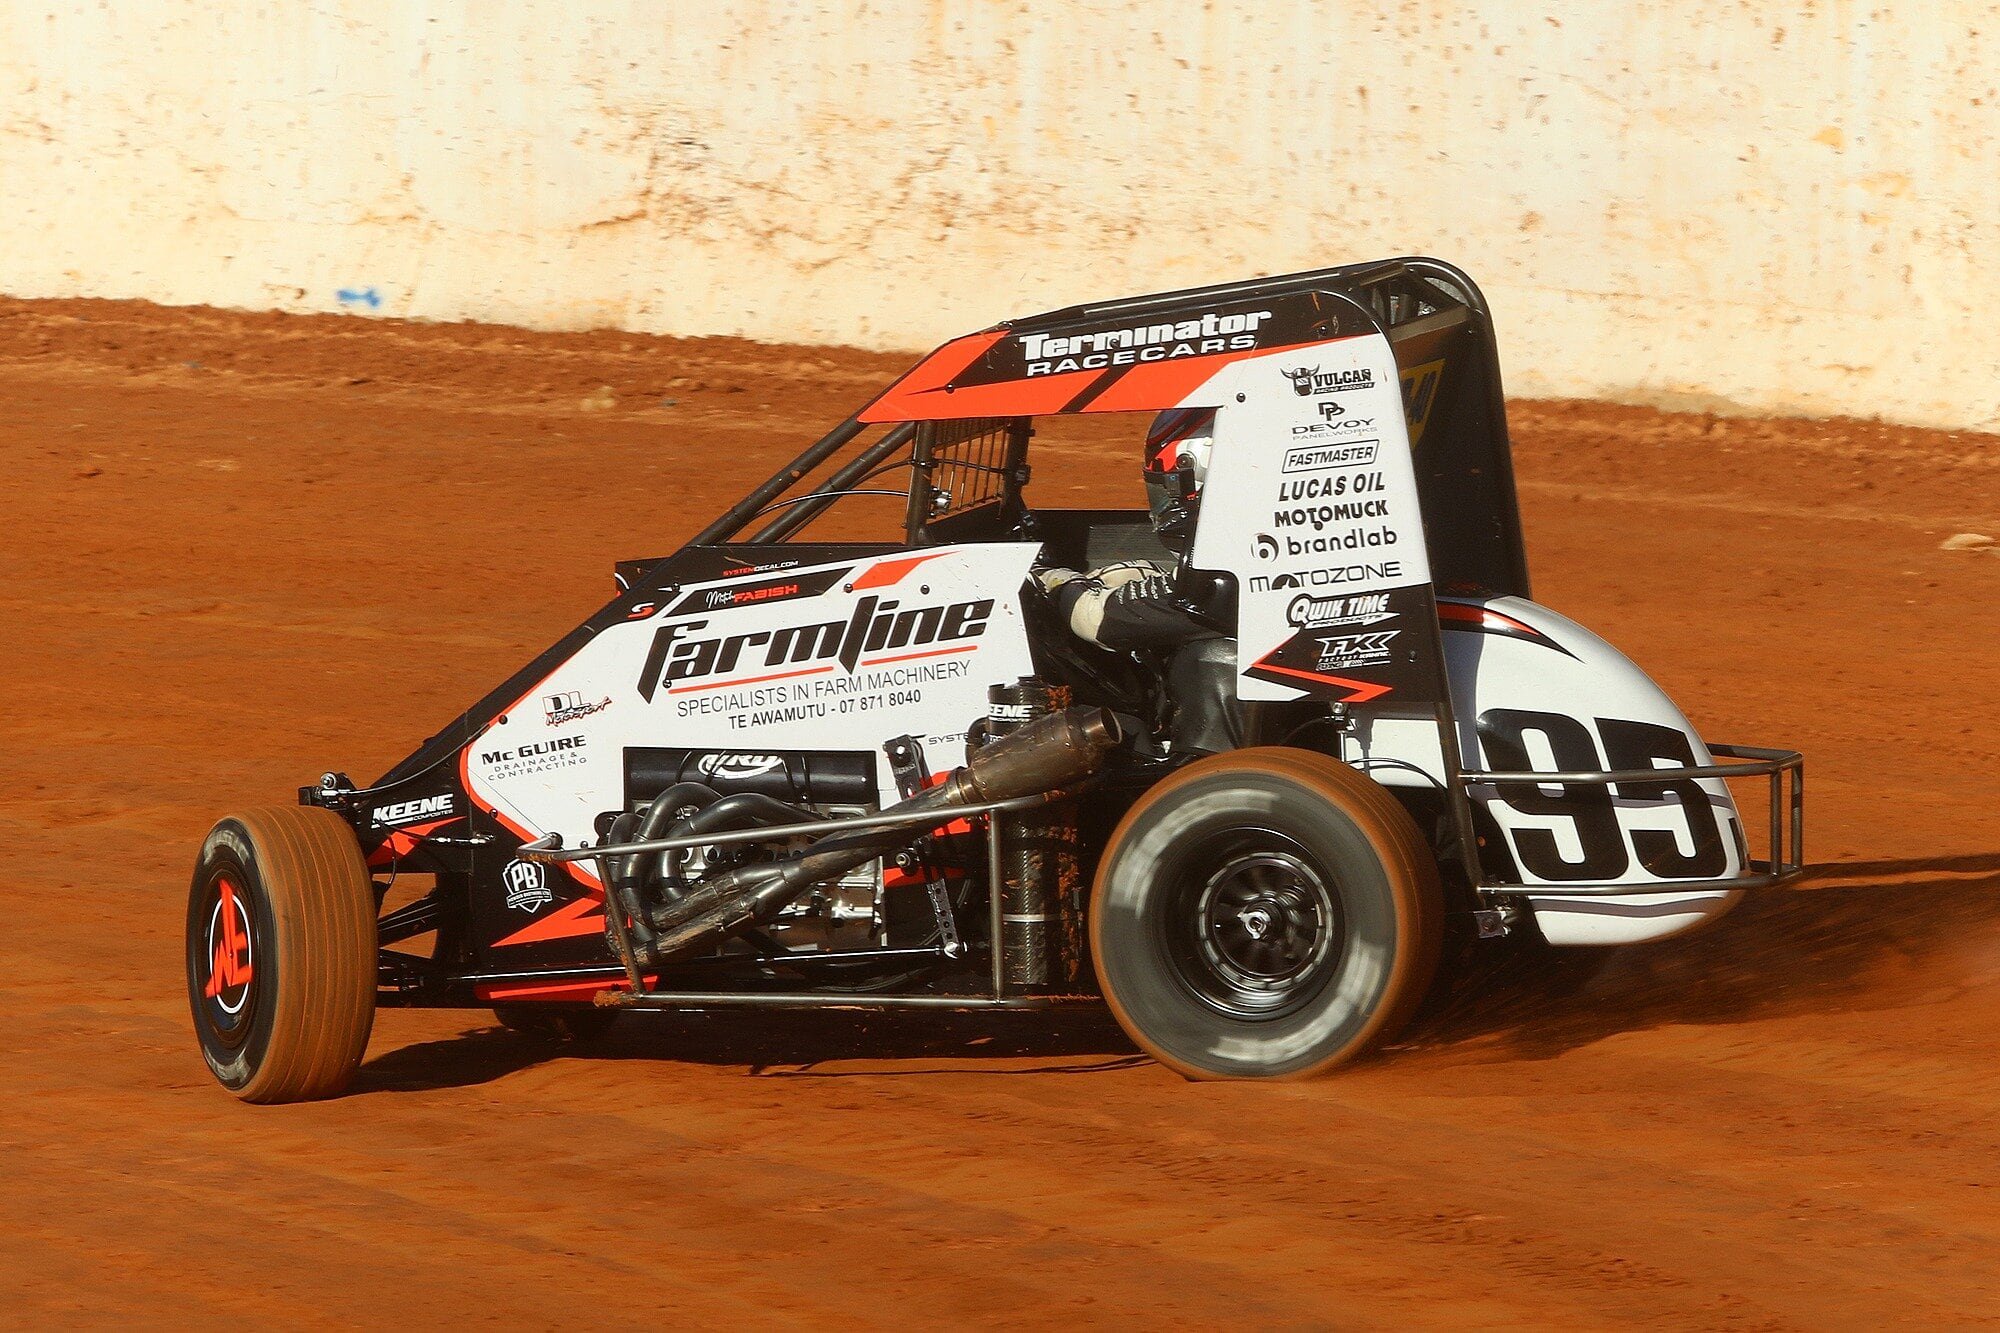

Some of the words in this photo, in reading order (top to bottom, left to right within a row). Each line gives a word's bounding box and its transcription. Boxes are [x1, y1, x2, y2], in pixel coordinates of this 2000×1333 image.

[1019, 310, 1272, 361] Terminator
[1027, 335, 1255, 377] RACECARS
[1314, 368, 1372, 387] VULCAN
[1292, 418, 1375, 434] DEVOY
[1292, 426, 1378, 440] PANELWORKS
[1288, 446, 1374, 467] FASTMASTER
[1278, 476, 1347, 502] LUCAS
[1353, 471, 1386, 493] OIL
[1274, 499, 1389, 530] MOTOMUCK
[1286, 525, 1397, 556] brandlab
[733, 584, 798, 604] FABISH
[1347, 593, 1391, 616] TIME
[542, 690, 592, 714] DL
[676, 688, 787, 718] SPECIALISTS
[792, 683, 811, 702] IN
[814, 675, 863, 699] FARM
[866, 659, 972, 692] MACHINERY
[728, 714, 749, 731] TE
[750, 702, 827, 727] AWAMUTU
[839, 698, 857, 714] 07
[860, 694, 884, 711] 871
[888, 690, 922, 707] 8040
[518, 735, 587, 758] GUIRE
[487, 757, 588, 781] CONTRACTING
[494, 754, 565, 773] DRAINAGE
[373, 793, 454, 823] KEENE
[1477, 708, 1728, 881] 95
[510, 862, 540, 892] PB
